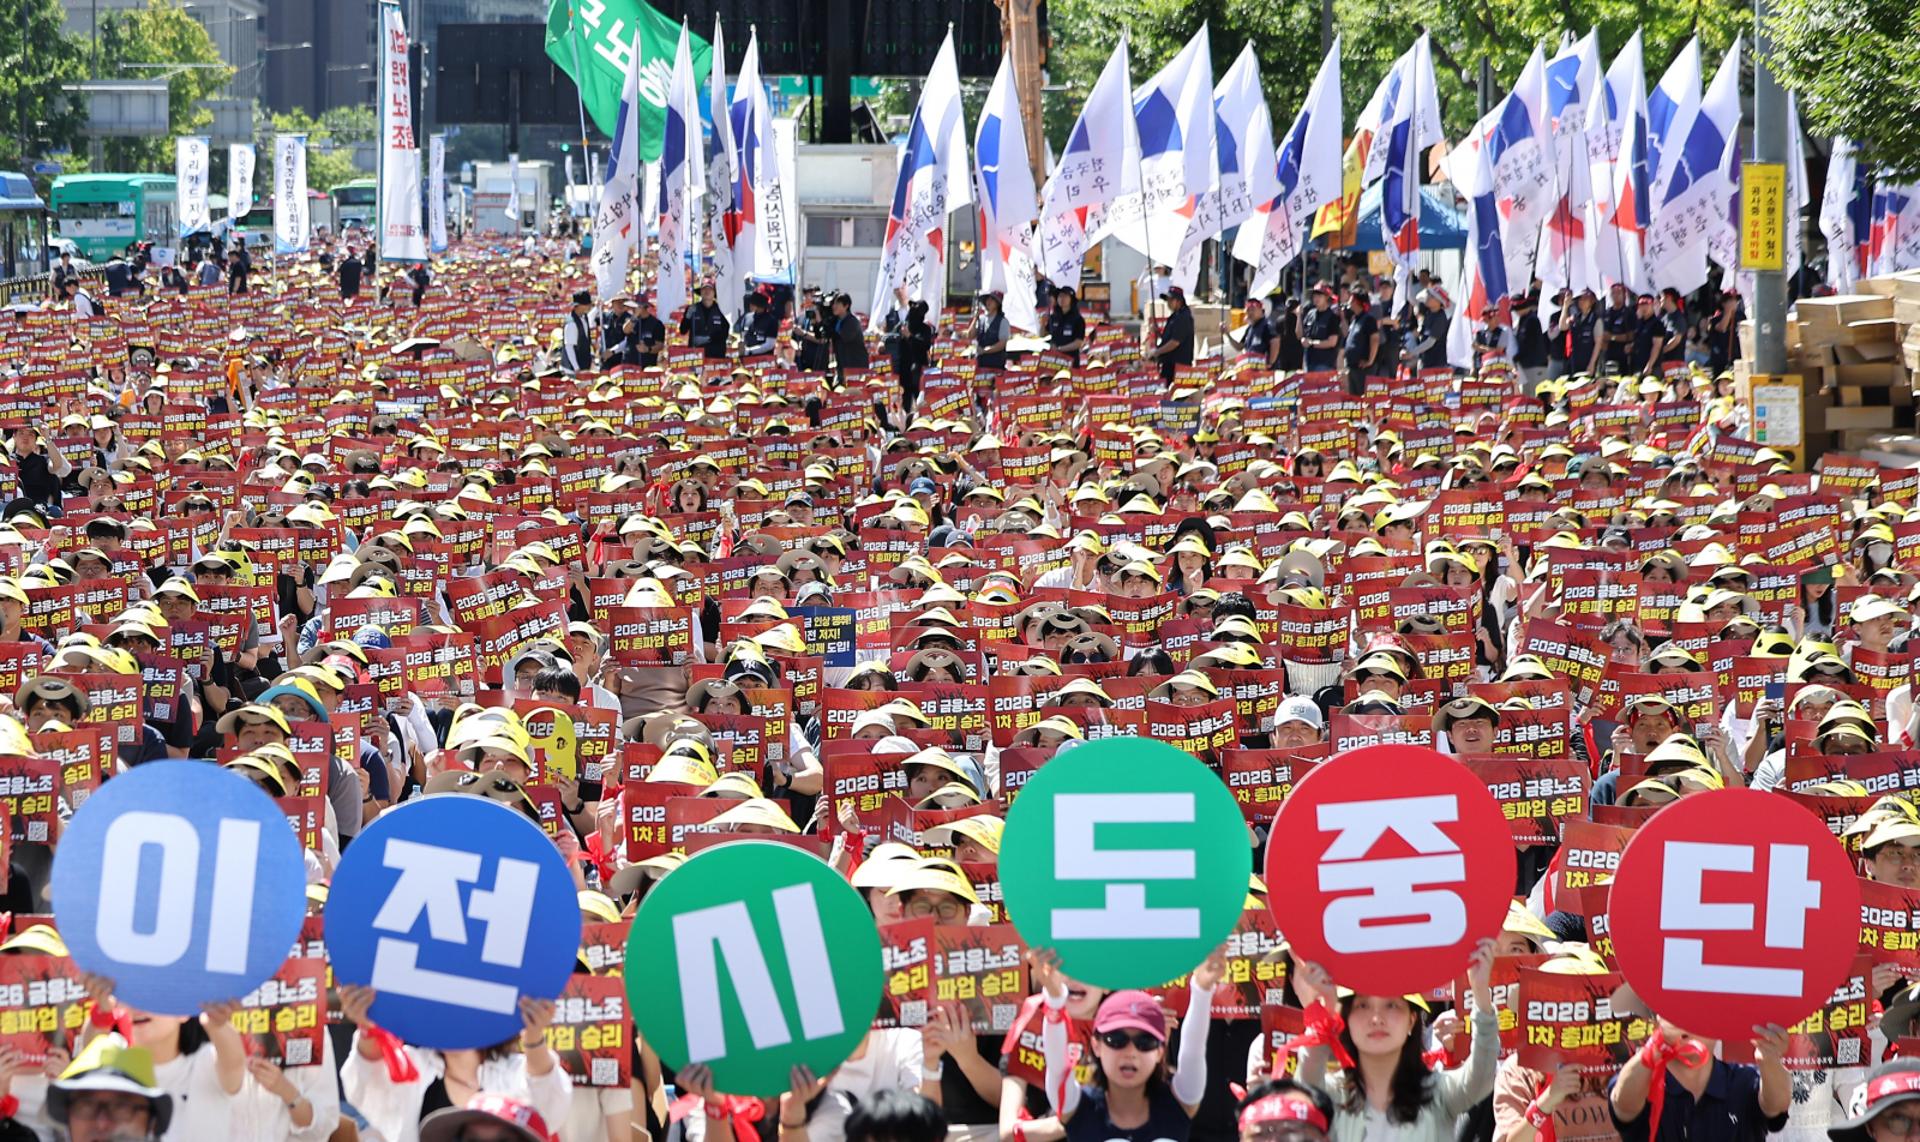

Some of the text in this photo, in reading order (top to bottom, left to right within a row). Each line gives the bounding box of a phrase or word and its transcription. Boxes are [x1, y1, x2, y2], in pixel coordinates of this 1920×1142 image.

[188, 143, 200, 226] 우리카드지부
[1017, 406, 1036, 415] 2026
[1595, 411, 1615, 419] 2026
[1656, 407, 1699, 418] 2026 금융노조
[1301, 435, 1321, 443] 2026
[1405, 436, 1453, 449] 2026 금융노조
[707, 451, 728, 460] 2026
[1002, 454, 1049, 466] 2026 금융노조
[852, 463, 864, 473] 승리
[1824, 467, 1879, 476] 2026 금융노조
[560, 472, 583, 482] 2026
[125, 487, 153, 500] 금융노조
[562, 482, 573, 492] 1차
[138, 499, 153, 510] 승리
[590, 502, 643, 515] 2026 금융노조
[1444, 503, 1504, 514] 2026 금융노조
[1443, 513, 1504, 525] 1차 총파업 승리
[1779, 504, 1838, 522] 2026 금융노조
[459, 528, 484, 540] 금융노조
[1768, 526, 1831, 558] 2026 금융노조
[133, 536, 166, 550] 금융노조
[262, 537, 294, 550] 금융노조
[469, 541, 484, 552] 승리
[1816, 538, 1834, 553] 승리
[149, 547, 166, 558] 승리
[278, 547, 295, 559] 승리
[1760, 575, 1796, 588] 금융노조
[88, 588, 123, 602] 금융노조
[456, 580, 520, 609] 2026 금융노조
[1565, 583, 1638, 598] 2026 금융노조
[1777, 587, 1796, 599] 승리
[32, 597, 70, 614] 금융노조
[104, 600, 123, 613] 승리
[461, 601, 506, 622] 1차 총파업
[1394, 600, 1467, 617] 2026 금융노조
[1564, 599, 1636, 614] 1차 총파업 승리
[50, 608, 71, 625] 승리
[334, 609, 411, 629] 2026 금융노조
[594, 609, 608, 620] 1차
[804, 614, 851, 628] 금 인상 쟁취!
[1110, 609, 1140, 621] 2026
[496, 612, 560, 650] 2026 금융노조
[614, 616, 688, 636] 2026 금융노조
[1281, 620, 1348, 634] 2026 금융노조
[614, 634, 689, 652] 1차 총파업 승리
[804, 628, 840, 642] 전 저지!
[1280, 633, 1347, 648] 1차 총파업 승리
[434, 646, 472, 662] 금융노조
[827, 641, 850, 653] 도입!
[1528, 638, 1606, 668] 2026 금융노조
[1428, 649, 1470, 663] 금융노조
[417, 660, 473, 682] 총파업 승리
[1447, 662, 1471, 677] 승리
[1547, 657, 1601, 684] 총파업 승리
[1854, 662, 1887, 676] 2026
[150, 684, 175, 698] 승리
[378, 681, 402, 694] 승리
[794, 682, 817, 697] 승리
[1236, 681, 1279, 698] 금융노조
[1664, 684, 1713, 704] 금융노조
[995, 694, 1032, 711] 2026
[1255, 696, 1278, 712] 승리
[1738, 690, 1754, 704] 1차
[111, 704, 137, 720] 승리
[940, 698, 986, 714] 금융노조
[1688, 702, 1713, 718] 승리
[960, 714, 985, 728] 승리
[996, 714, 1012, 729] 1차
[1151, 711, 1233, 737] 2026 금융노조
[1212, 728, 1235, 748] 승리
[1515, 722, 1564, 741] 금융노조
[580, 740, 608, 756] 승리
[731, 748, 758, 764] 승리
[1538, 740, 1564, 757] 승리
[64, 766, 91, 785] 승리
[1230, 769, 1272, 786] 2026
[0, 776, 53, 794] 금융노조
[835, 778, 878, 794] 2026
[1525, 777, 1582, 798] 금융노조
[22, 797, 51, 815] 승리
[1502, 796, 1582, 820] 총파업 승리
[632, 826, 653, 842] 1차
[1051, 793, 1200, 939] 도
[1568, 850, 1619, 868] 2026
[1316, 794, 1467, 954] 중
[1566, 872, 1589, 888] 1차
[96, 811, 260, 975] 이
[371, 838, 540, 1015] 전
[1660, 840, 1821, 997] 단
[949, 946, 1019, 971] 금융노조
[672, 882, 845, 1064] 시
[890, 966, 928, 993] 승리
[982, 971, 1019, 993] 승리
[282, 1003, 316, 1030] 승리
[1528, 1002, 1589, 1021] 2026
[1830, 1004, 1866, 1030] 승리
[581, 1024, 622, 1050] 승리
[1527, 1022, 1621, 1048] 1차 총파업
[1555, 1105, 1606, 1126] NOW
